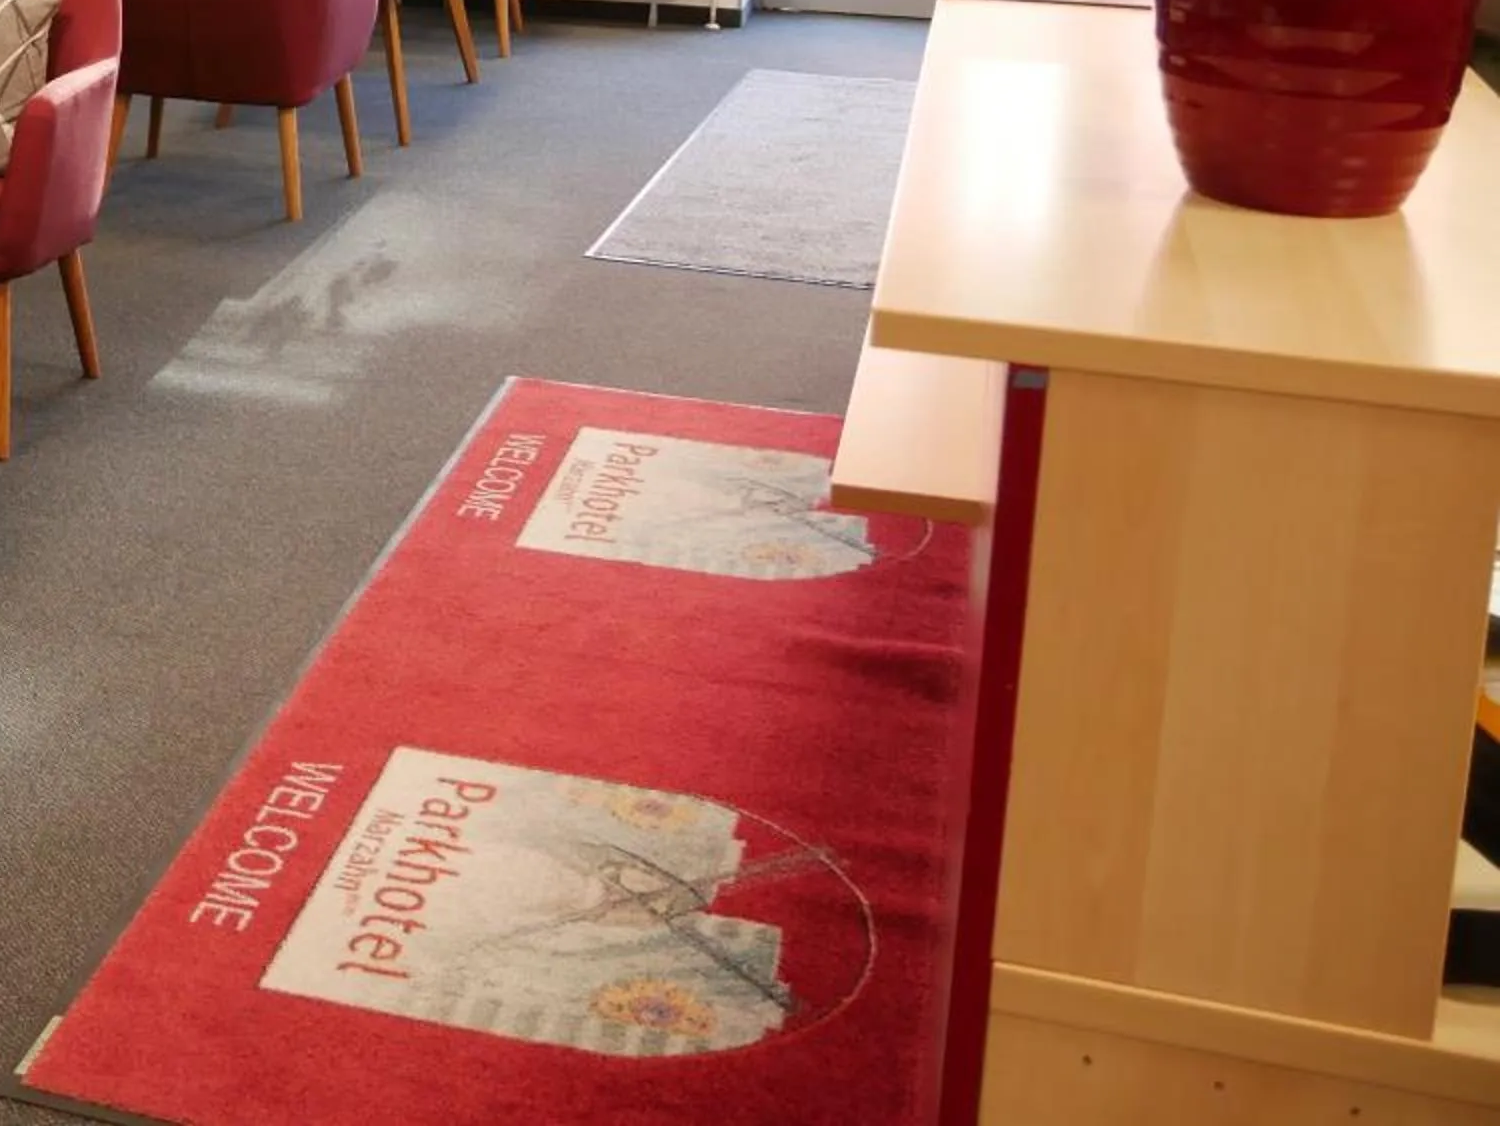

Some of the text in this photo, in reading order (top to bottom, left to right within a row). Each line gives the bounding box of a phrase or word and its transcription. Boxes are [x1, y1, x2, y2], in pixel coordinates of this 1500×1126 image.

[457, 433, 546, 521] WELCOME
[564, 442, 659, 544] Parkhotel
[190, 761, 344, 932] WELCOME
[333, 808, 405, 892] Marzahn
[337, 777, 497, 980] Parkhotel
